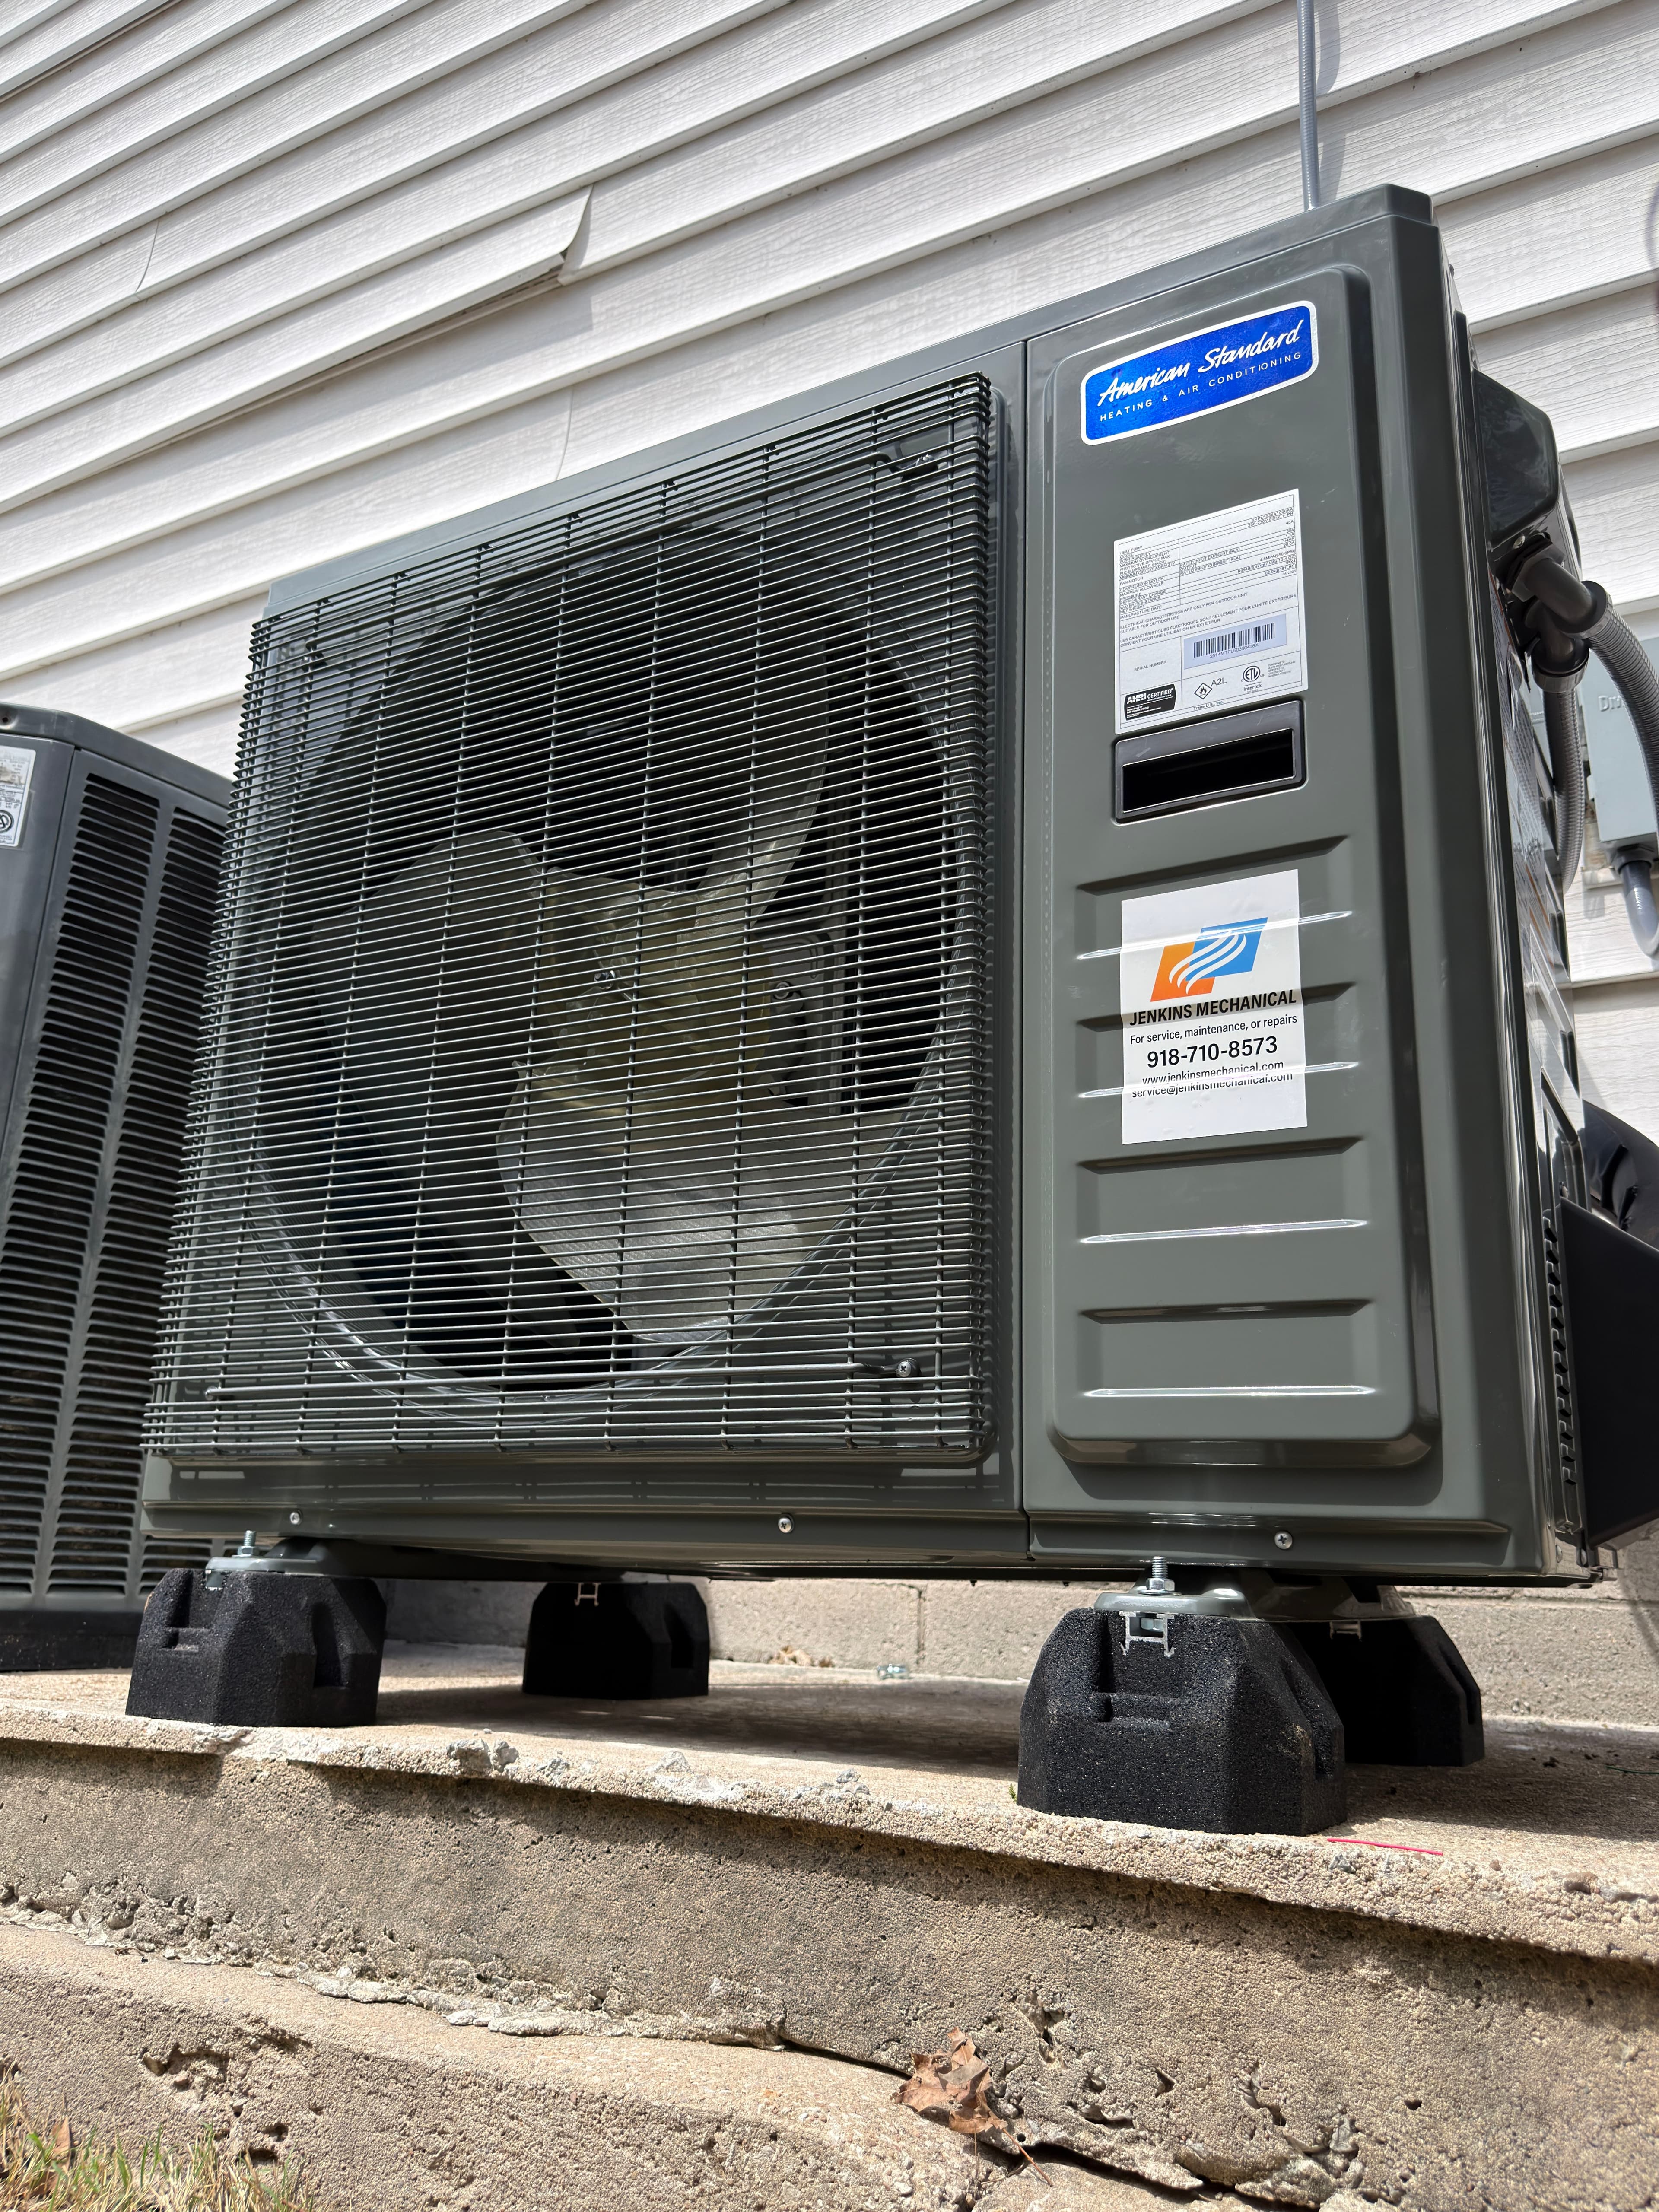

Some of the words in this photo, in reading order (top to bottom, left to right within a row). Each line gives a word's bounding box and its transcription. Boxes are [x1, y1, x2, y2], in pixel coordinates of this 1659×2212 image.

[1097, 362, 1190, 407] American
[1198, 320, 1304, 374] Standard
[1100, 400, 1153, 422] HEATING
[1178, 385, 1198, 397] AIR
[1208, 351, 1302, 387] CONDITIONING
[1119, 559, 1138, 568] MAXIMUM
[1139, 551, 1169, 562] OVERCURRENT
[1208, 551, 1227, 559] CURRENT
[1119, 562, 1144, 572] PROTECTIVE
[1132, 564, 1150, 572] BREAKER
[1155, 561, 1175, 570] AMPACITY
[1208, 559, 1228, 568] CURRENT
[1120, 581, 1147, 592] COMPRESSOR
[1139, 582, 1163, 591] ALLOWABLE
[1120, 593, 1141, 601] PRESSURE
[1120, 595, 1148, 605] REFRIGERANT
[1135, 596, 1160, 605] RESISTANCE
[1120, 620, 1144, 629] ELECTRICAL
[1145, 610, 1183, 623] CHARACTERISTICS
[1215, 595, 1236, 604] OUTDOOR
[1120, 608, 1150, 619] MANUFACTURE
[1212, 609, 1237, 619] SEULEMENT
[1120, 626, 1139, 634] SUITABLE
[1150, 618, 1170, 626] OUTDOOR
[1120, 639, 1141, 647] CONVIENT
[1163, 626, 1189, 636] UTILISATION
[1211, 677, 1227, 686] A2L
[1126, 693, 1146, 704] AHRI
[1129, 1004, 1192, 1026] JENKINS
[1196, 989, 1296, 1017] MECHANICAL
[1130, 1034, 1144, 1044] For
[1147, 1029, 1182, 1043] service,
[1185, 1020, 1248, 1038] maintenance,
[1251, 1020, 1260, 1028] or
[1263, 1013, 1297, 1029] repairs
[1147, 1036, 1277, 1068] 918-710-8573
[1142, 1059, 1283, 1084] www.jenkinsmechanical.com
